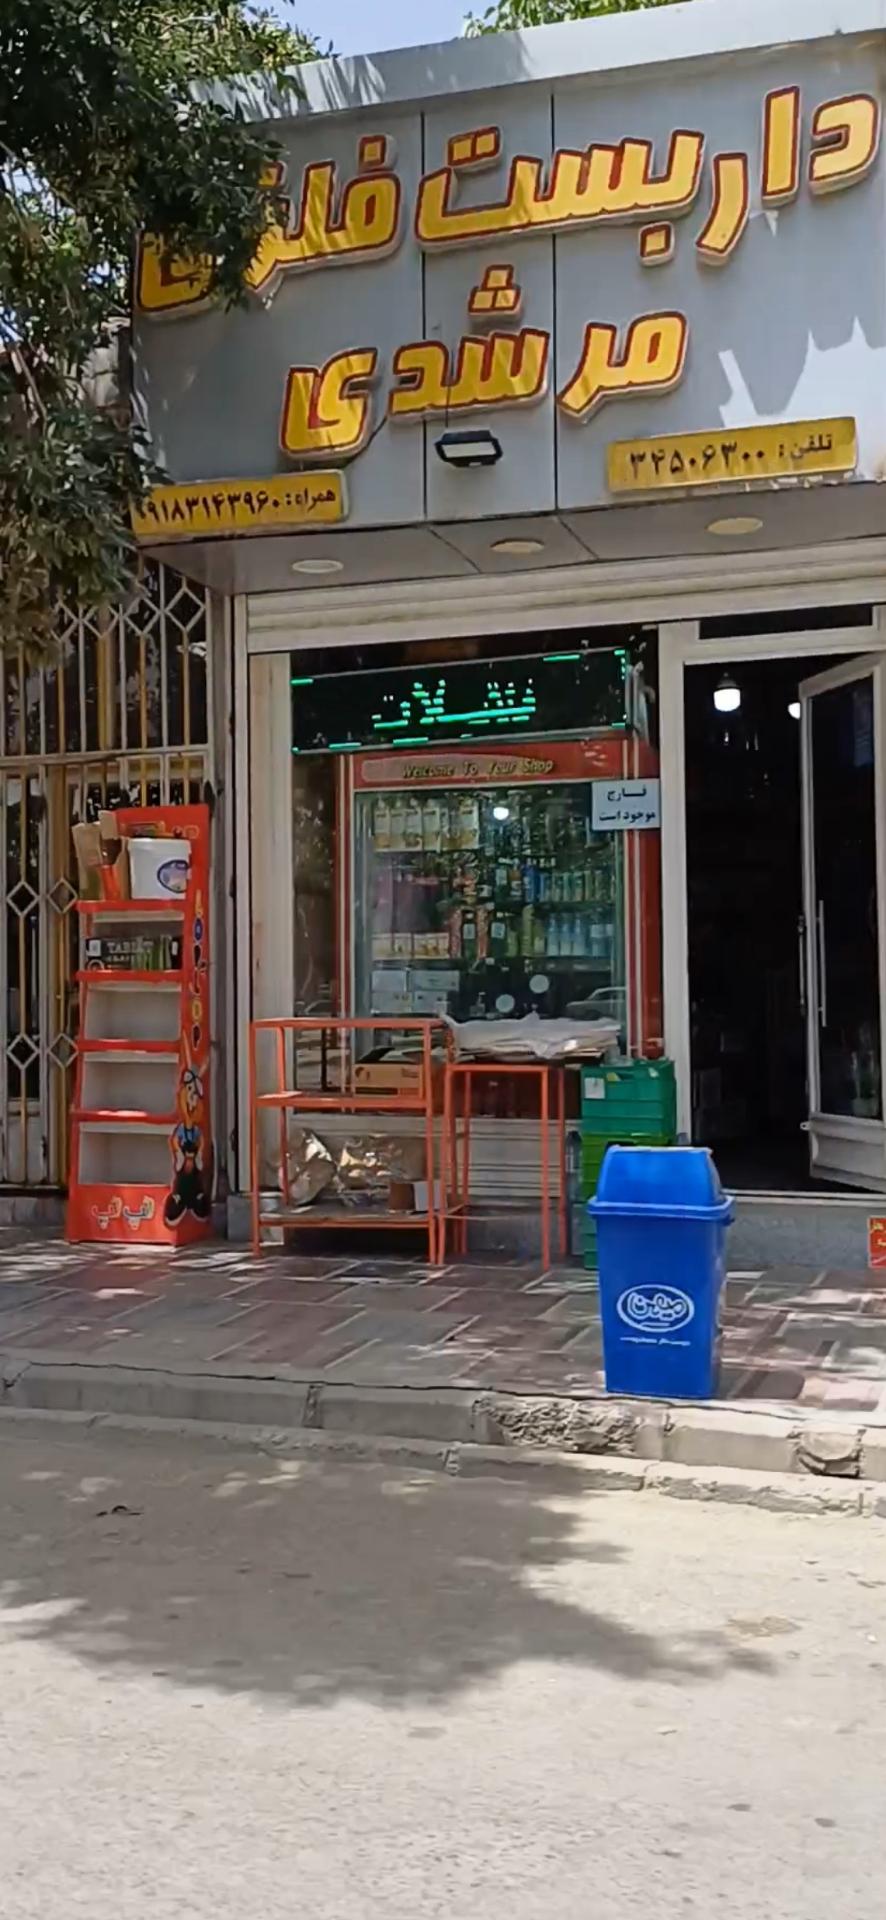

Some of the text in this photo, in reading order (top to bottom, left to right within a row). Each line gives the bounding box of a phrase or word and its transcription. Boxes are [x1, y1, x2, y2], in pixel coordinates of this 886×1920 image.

[416, 86, 880, 264] داربست
[279, 265, 688, 460] مرشدی
[629, 441, 765, 480] ۳۴۵۰۶۳۰۰
[403, 758, 554, 779] Welcome To Your Shop
[598, 810, 657, 824] موجود است
